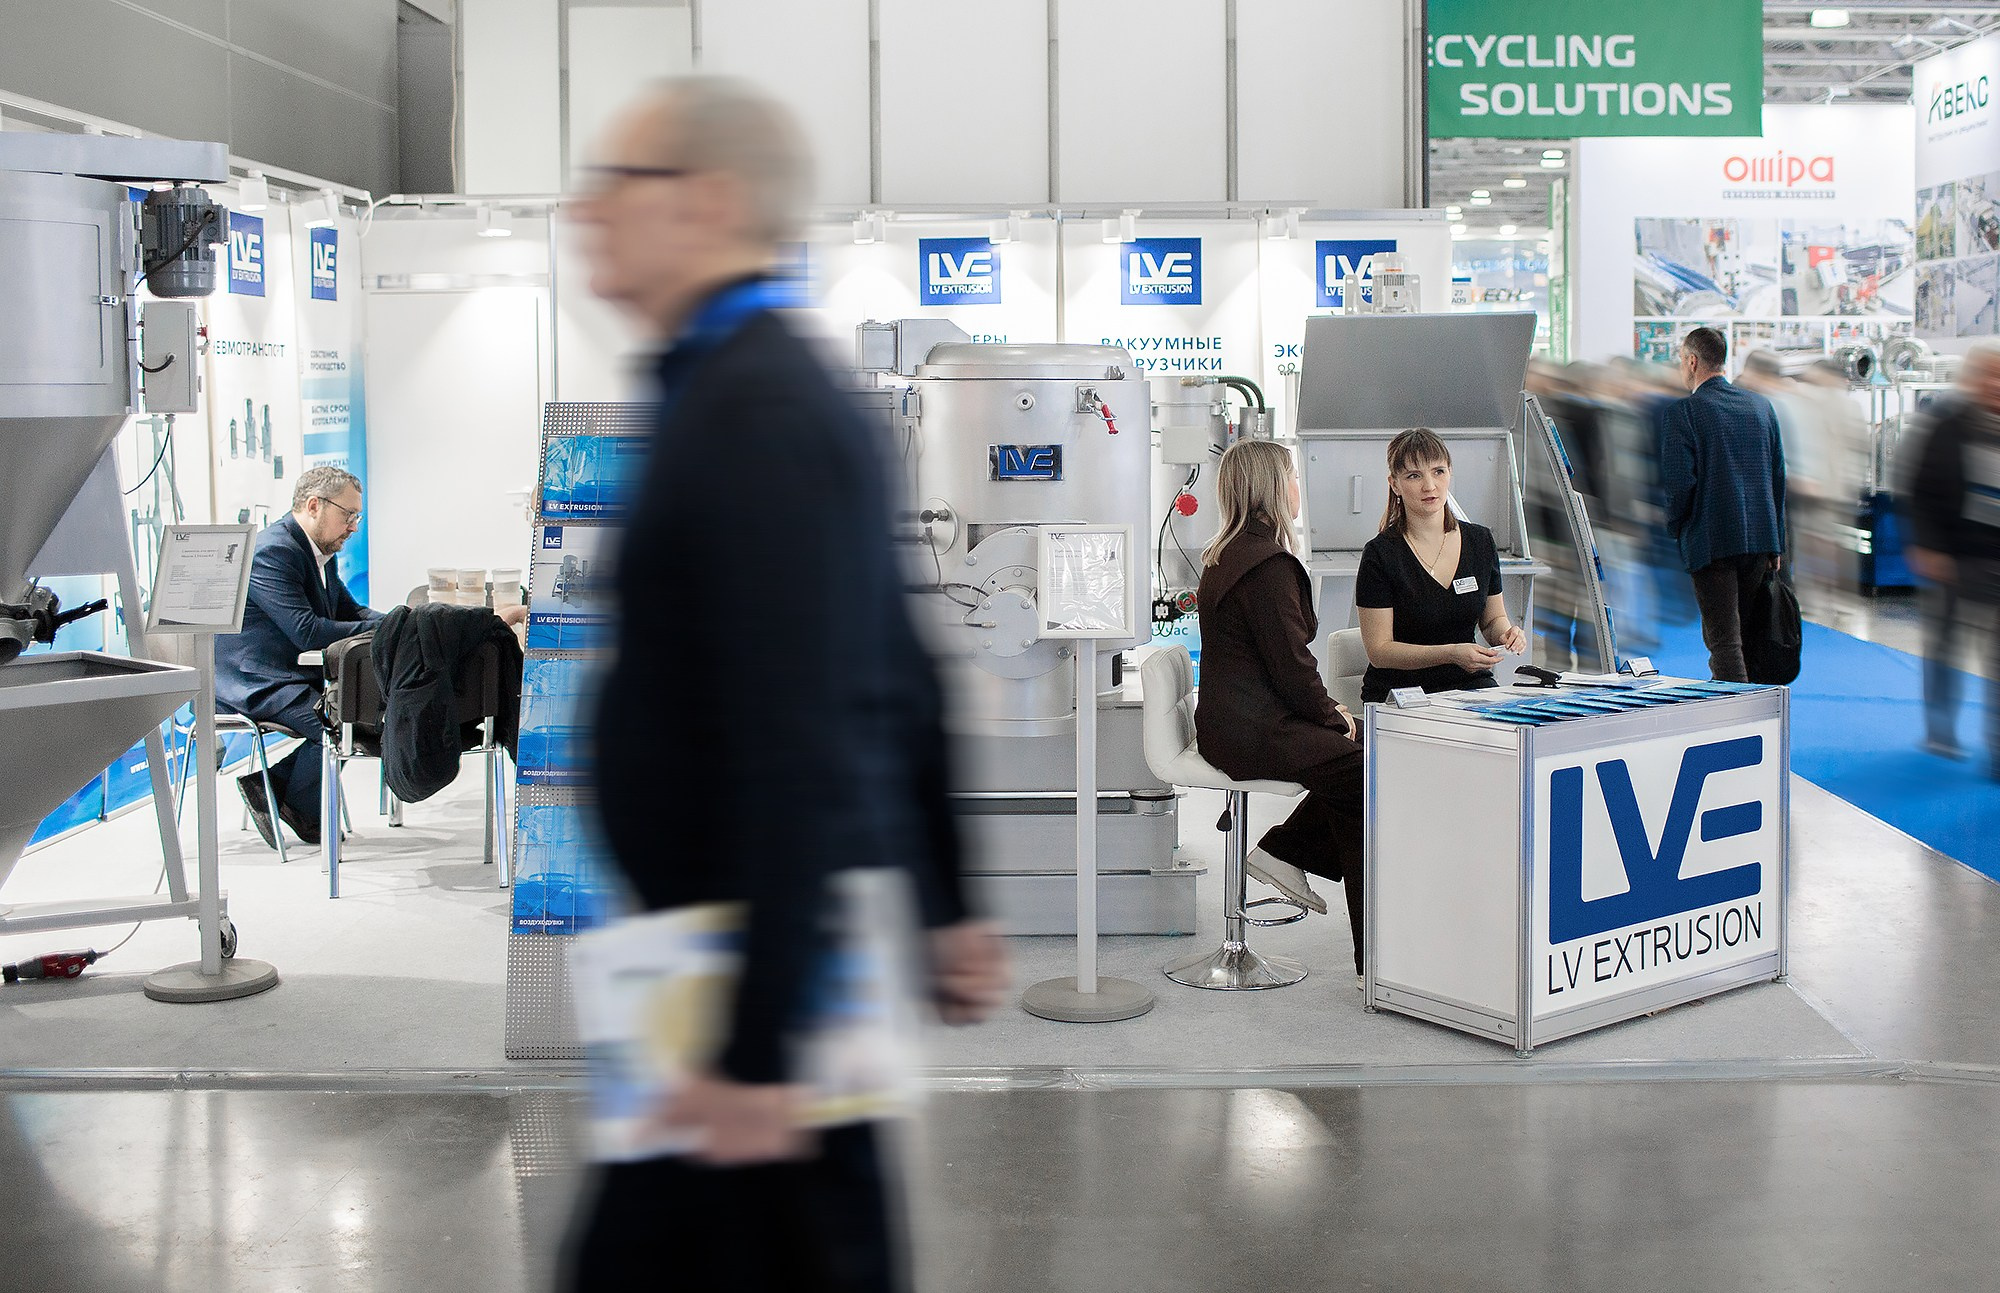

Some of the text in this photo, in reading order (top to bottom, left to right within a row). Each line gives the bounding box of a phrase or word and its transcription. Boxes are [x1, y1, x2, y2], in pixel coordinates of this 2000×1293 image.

[1460, 82, 1733, 116] SOLUTIONS
[230, 230, 262, 272] LVE
[312, 241, 336, 279] LVE
[928, 252, 993, 286] LVE
[1129, 252, 1193, 285] LVE
[929, 284, 993, 295] LV EXTRUSION
[1129, 284, 1193, 295] LV EXTRUSION
[1325, 287, 1337, 297] LV
[1274, 344, 1303, 358] ЭК
[999, 448, 1054, 478] LVE
[560, 503, 603, 511] EXTRUSION
[175, 533, 191, 541] LVE
[545, 536, 561, 545] LVE
[546, 616, 587, 624] EXTRUSION
[1549, 734, 1763, 946] LVE
[1548, 901, 1762, 995] LV EXTRUSION
